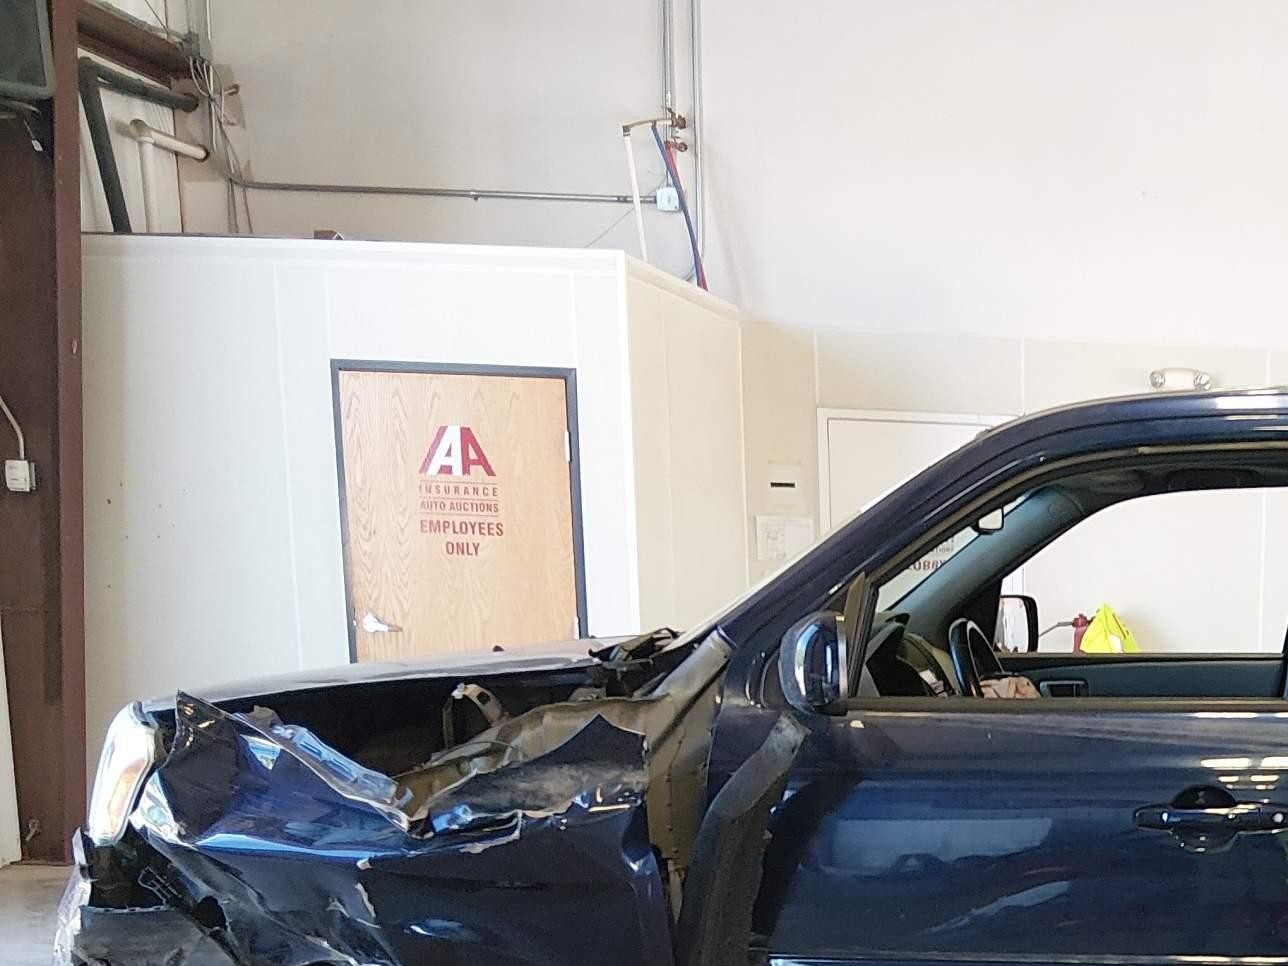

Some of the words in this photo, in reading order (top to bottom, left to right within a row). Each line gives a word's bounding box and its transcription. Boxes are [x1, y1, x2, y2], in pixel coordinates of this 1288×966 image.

[419, 485, 498, 497] INSURANCE
[420, 500, 446, 511] AUTO
[449, 501, 499, 513] AUCTIONS
[420, 519, 504, 537] EMPLOYEES
[445, 541, 481, 556] ONLY
